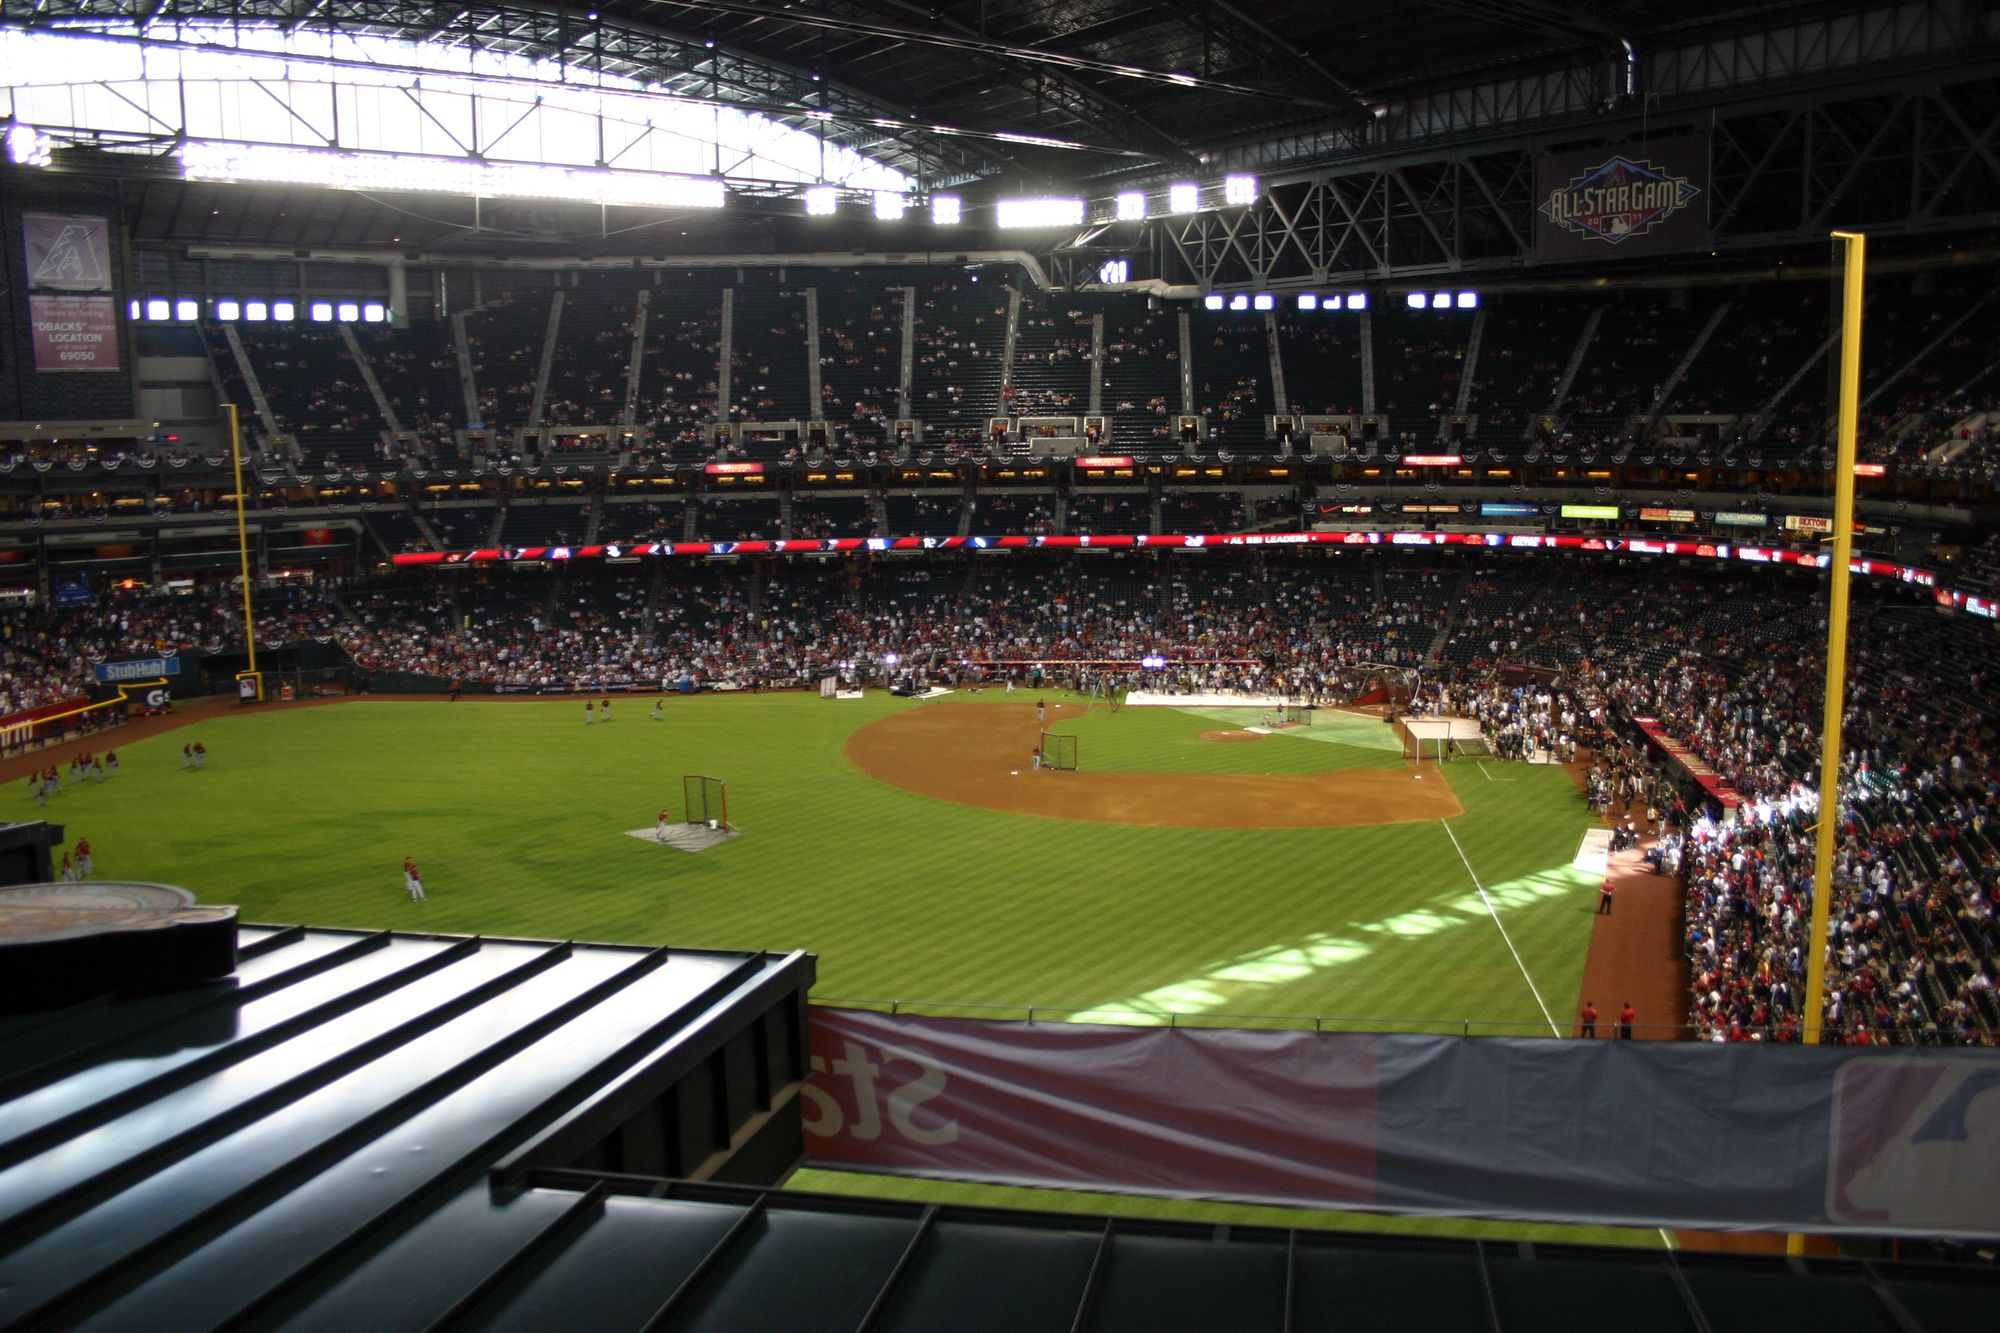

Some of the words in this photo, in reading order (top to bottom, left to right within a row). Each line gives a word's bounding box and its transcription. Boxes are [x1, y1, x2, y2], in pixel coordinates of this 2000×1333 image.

[1632, 180, 1685, 217] GAME
[1588, 217, 1599, 225] 20
[49, 333, 103, 342] LOCATION
[60, 351, 96, 360] 69050
[1798, 517, 1826, 527] SEXTON
[1265, 535, 1308, 543] LEADERS
[106, 659, 167, 679] StubHub!
